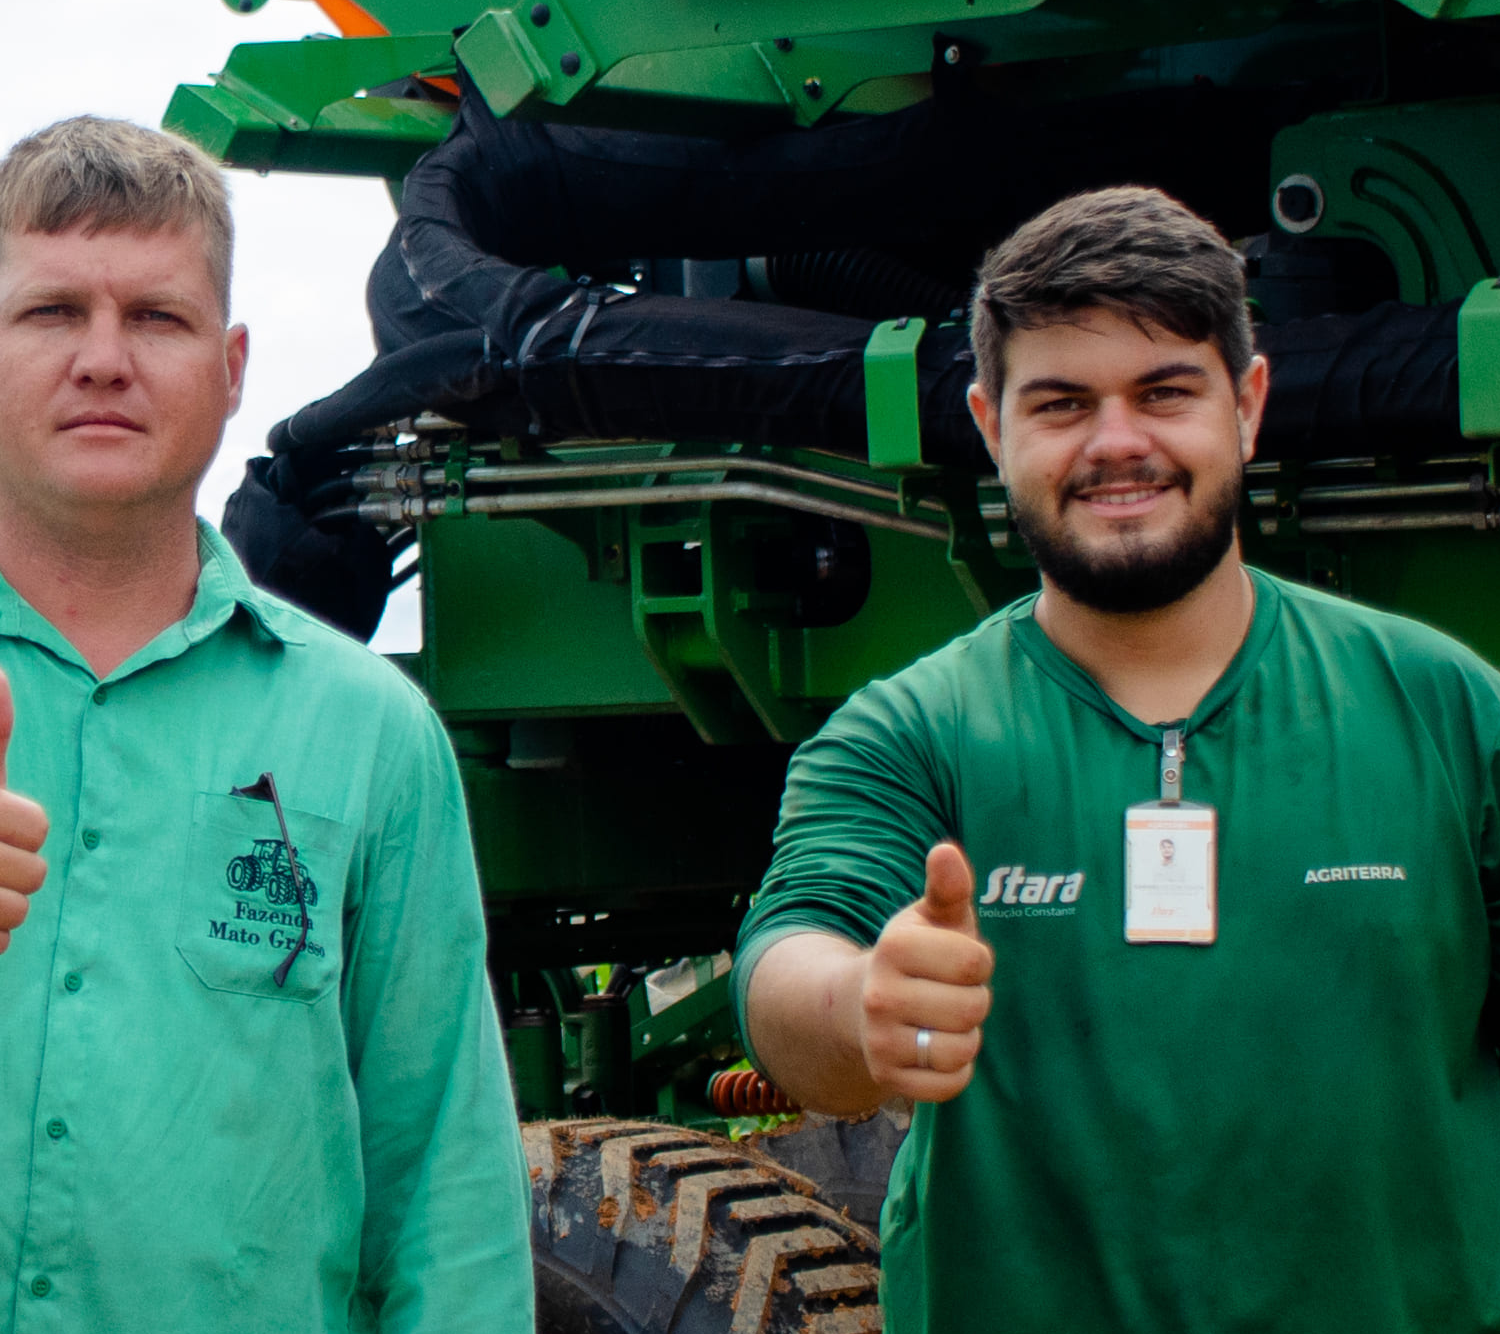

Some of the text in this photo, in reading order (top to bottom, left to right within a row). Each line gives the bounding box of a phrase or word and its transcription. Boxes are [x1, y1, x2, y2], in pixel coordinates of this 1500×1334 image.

[979, 865, 1085, 904] Stara
[1304, 865, 1407, 884] AGRITERRA
[208, 919, 260, 945] Mato
